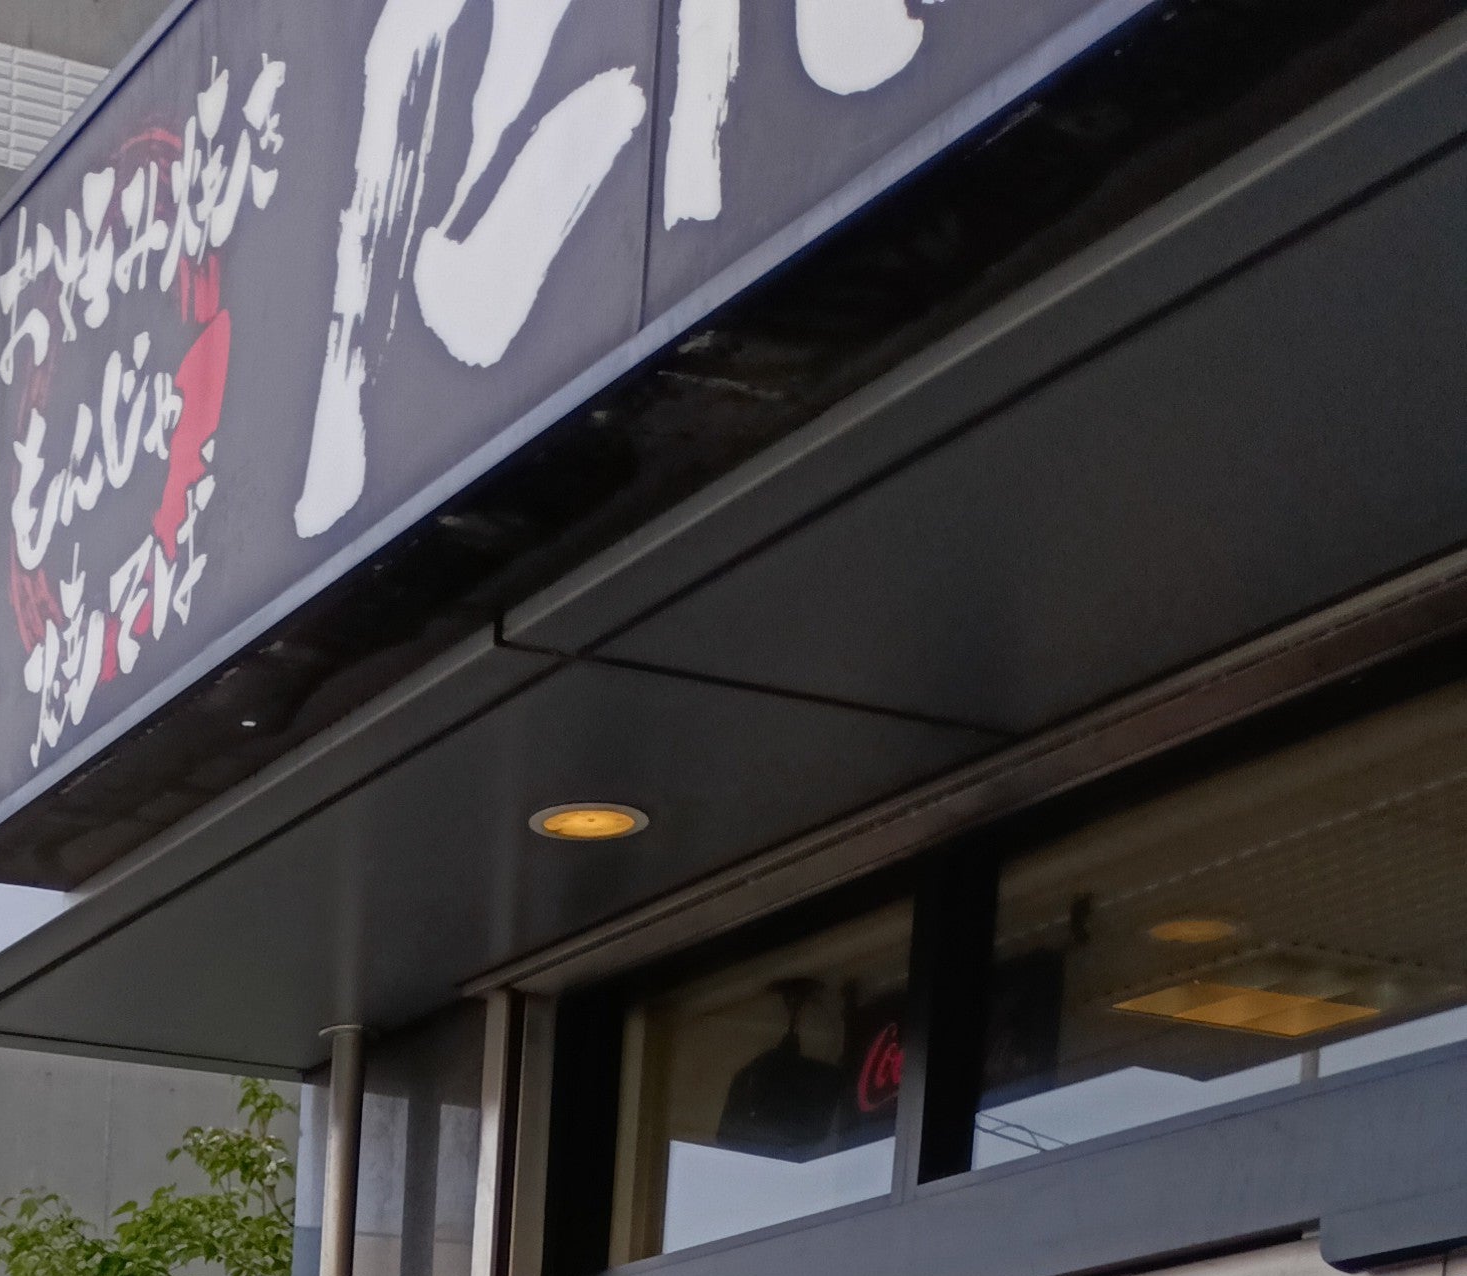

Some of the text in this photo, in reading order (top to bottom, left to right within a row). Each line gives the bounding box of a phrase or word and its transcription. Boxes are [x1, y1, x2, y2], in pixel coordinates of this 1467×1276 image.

[0, 53, 286, 385] お好み焼き
[12, 331, 183, 571] もんじゃ
[24, 439, 216, 767] 焼そば
